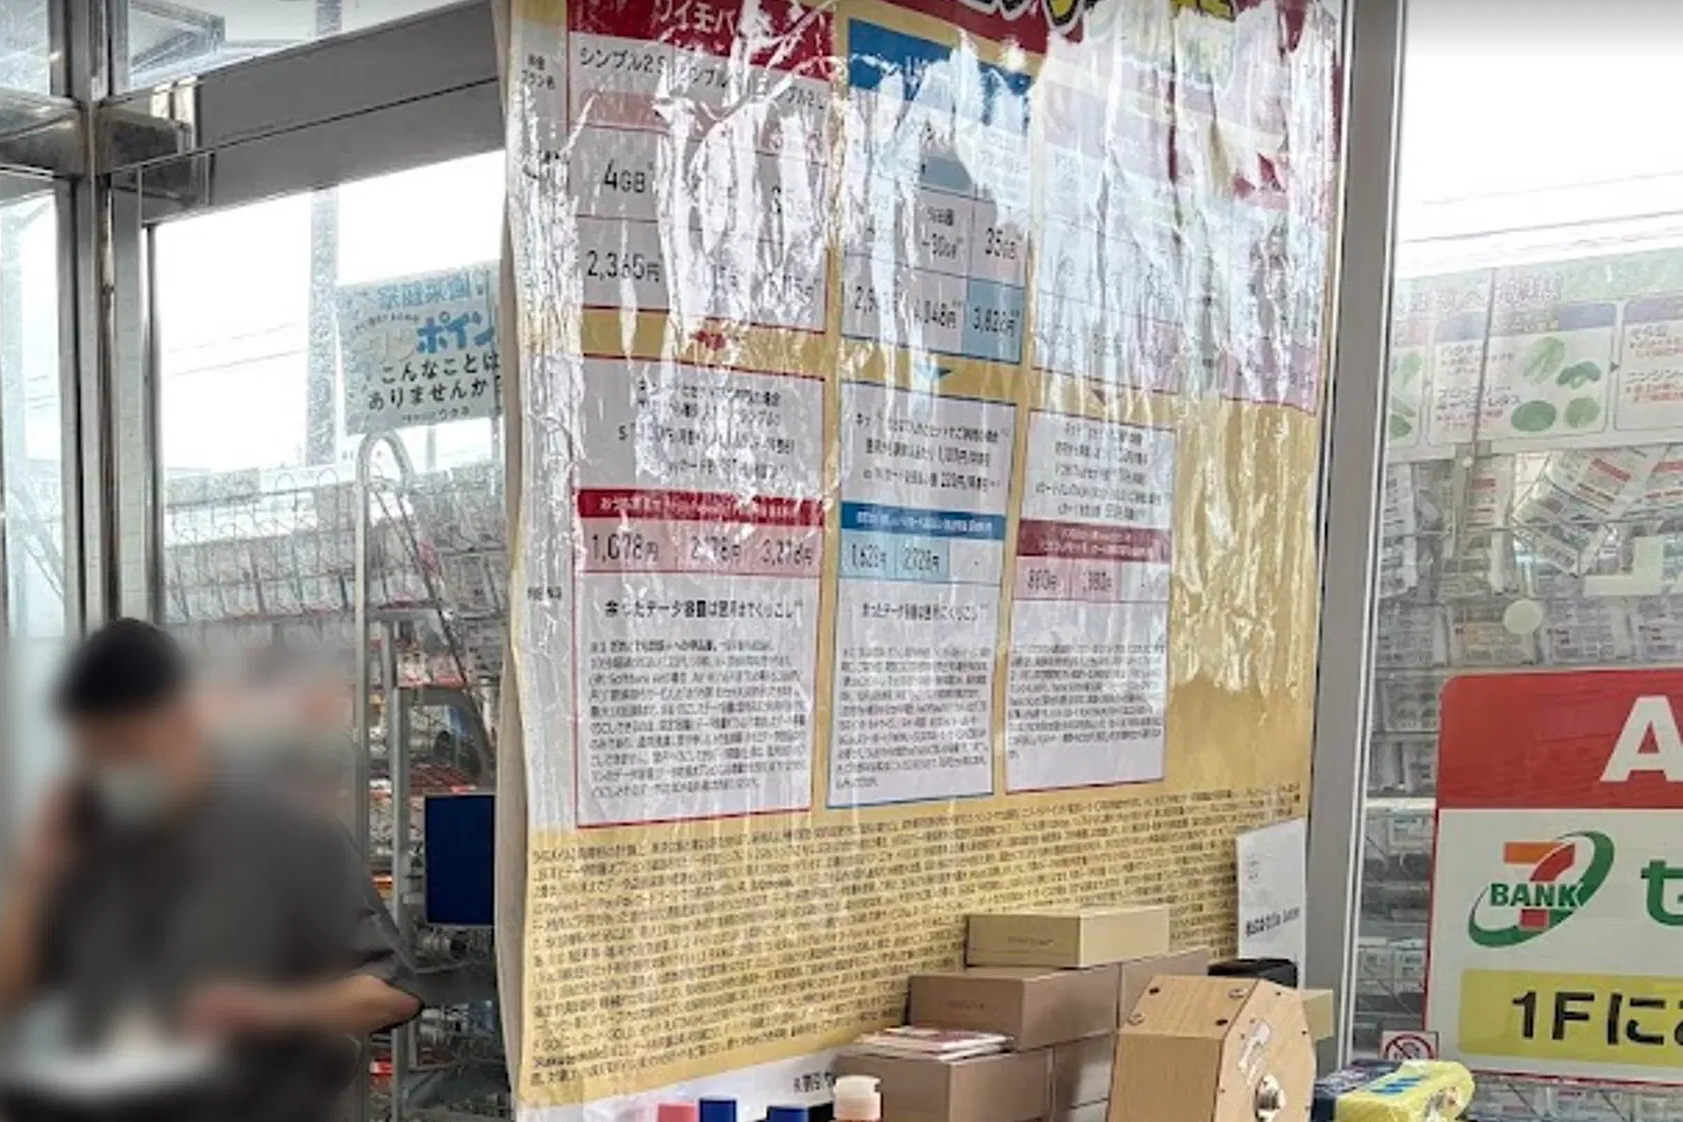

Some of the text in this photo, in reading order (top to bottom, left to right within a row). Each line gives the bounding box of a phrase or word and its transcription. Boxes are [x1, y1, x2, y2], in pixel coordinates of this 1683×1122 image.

[603, 158, 646, 194] 4GB
[585, 249, 661, 283] 2,365円
[381, 351, 500, 384] こんなことは
[1489, 882, 1585, 908] BANK
[1512, 990, 1683, 1046] 1Fに
